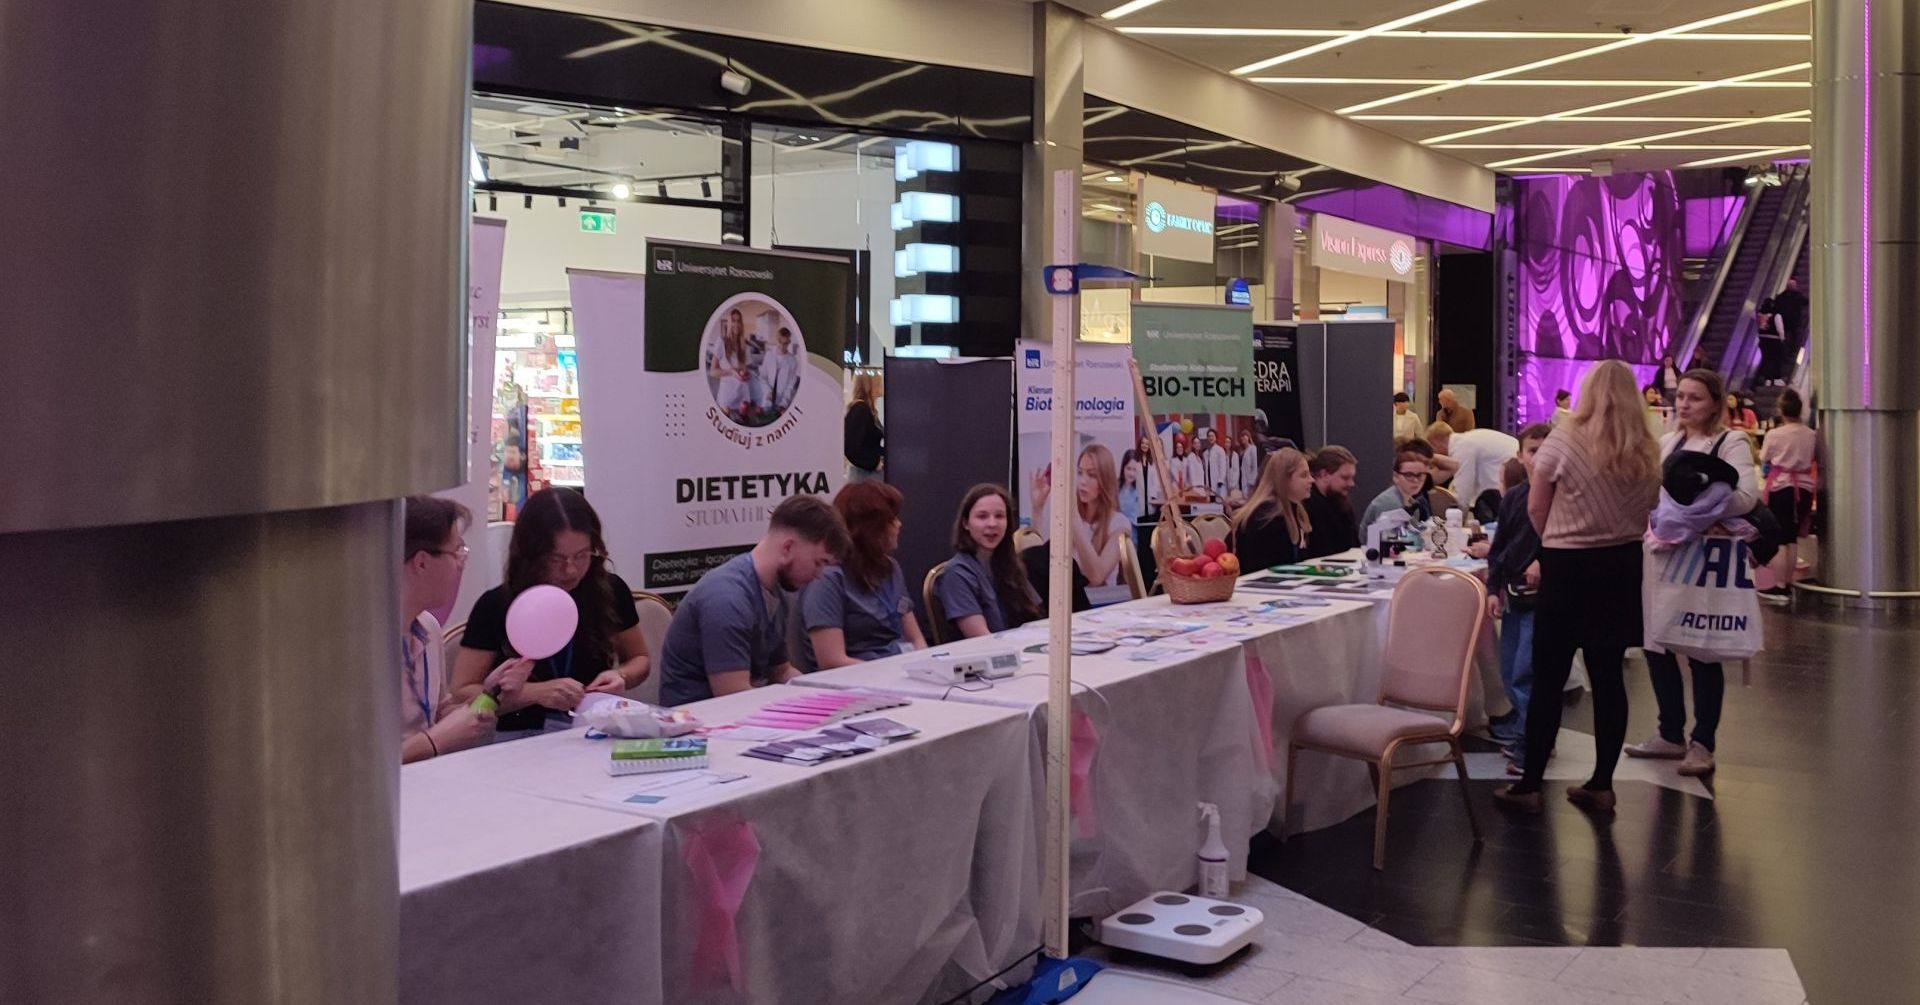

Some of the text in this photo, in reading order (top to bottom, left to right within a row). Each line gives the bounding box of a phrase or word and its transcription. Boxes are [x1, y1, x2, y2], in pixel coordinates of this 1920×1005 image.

[1321, 230, 1387, 264] Vision Express
[1142, 375, 1246, 398] BIO-TECH
[1025, 396, 1125, 414] Biotnologia
[705, 405, 753, 451] Studiuj
[756, 436, 763, 447] z
[676, 471, 830, 504] DIETETYKA
[685, 508, 738, 528] STUDIA
[1681, 611, 1748, 632] ACTION
